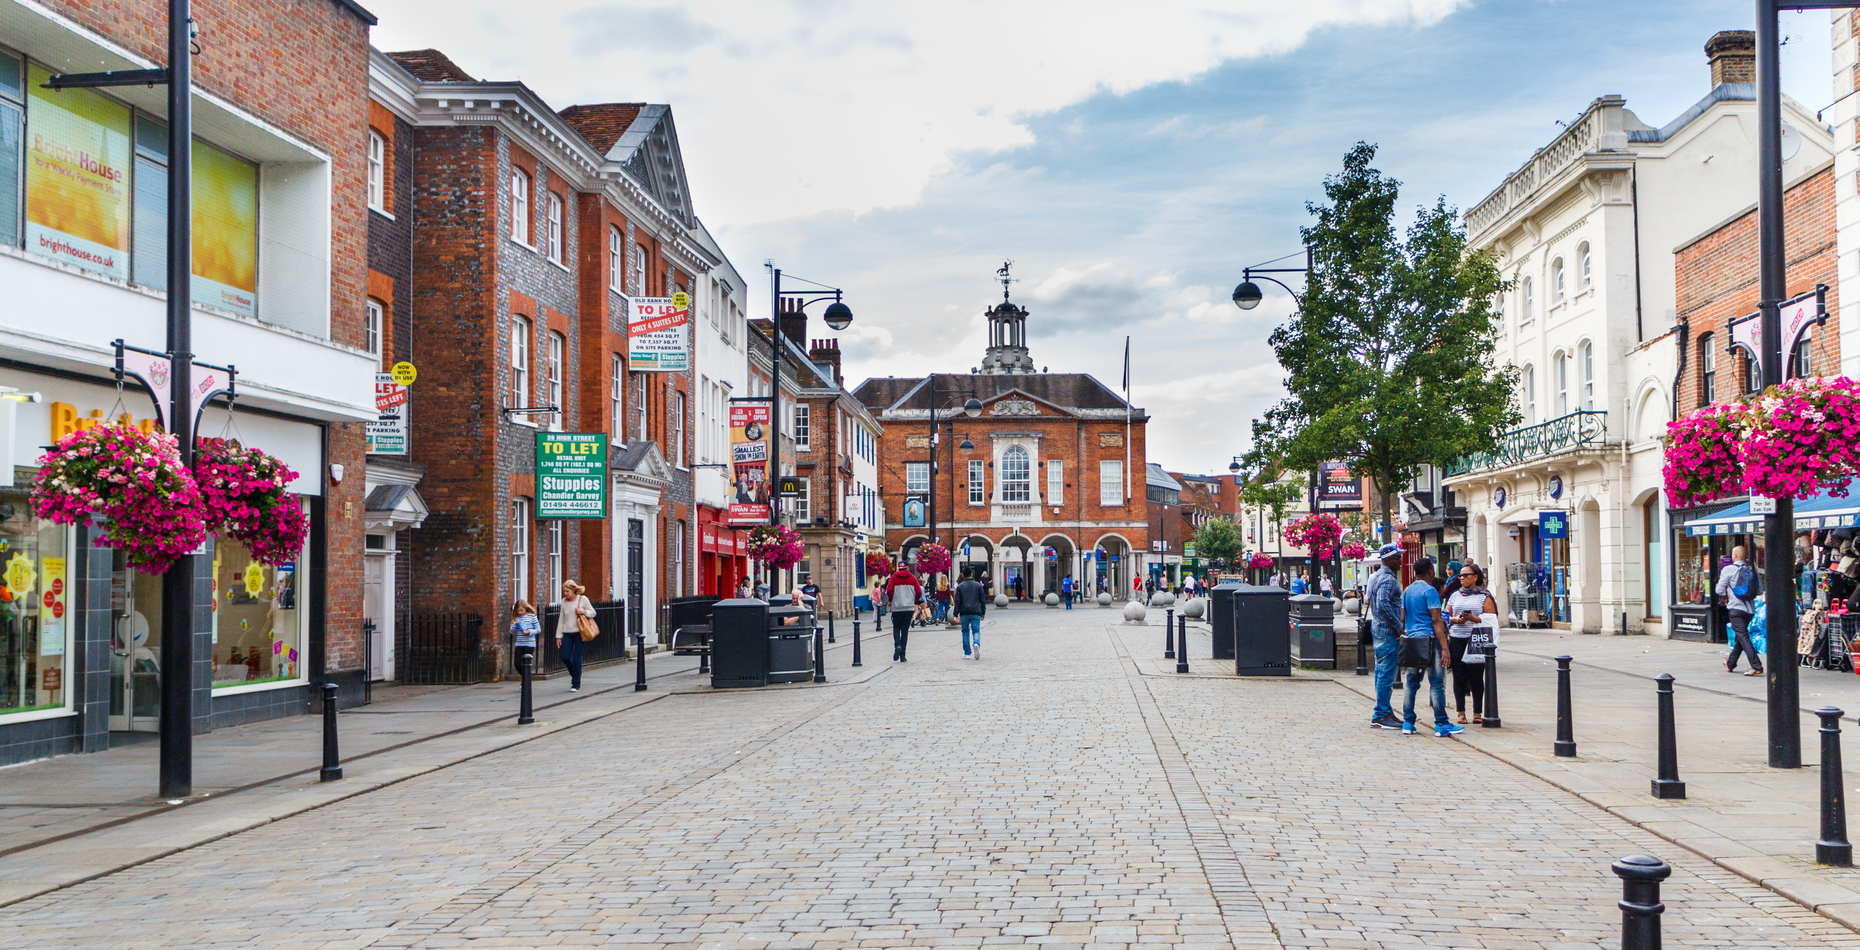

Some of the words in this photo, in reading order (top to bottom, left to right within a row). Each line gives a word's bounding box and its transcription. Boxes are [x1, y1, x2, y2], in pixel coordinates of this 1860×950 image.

[34, 132, 122, 184] BrightHouse
[34, 154, 50, 169] Your
[51, 163, 76, 181] Weekly
[76, 172, 104, 191] Payment
[105, 183, 122, 198] Store
[40, 234, 114, 268] brighthouse.co.uk
[638, 305, 654, 314] TO
[658, 306, 678, 314] LET
[631, 324, 646, 333] ONLY
[652, 318, 672, 328] SUITES
[672, 314, 684, 322] LEFT
[376, 383, 398, 394] LET
[389, 393, 404, 404] LEFT
[542, 442, 564, 454] TO
[570, 443, 599, 454] LET
[735, 453, 746, 461] SHOW
[752, 452, 765, 460] EARTH
[543, 477, 600, 492] Stupples
[1472, 634, 1489, 642] BHS
